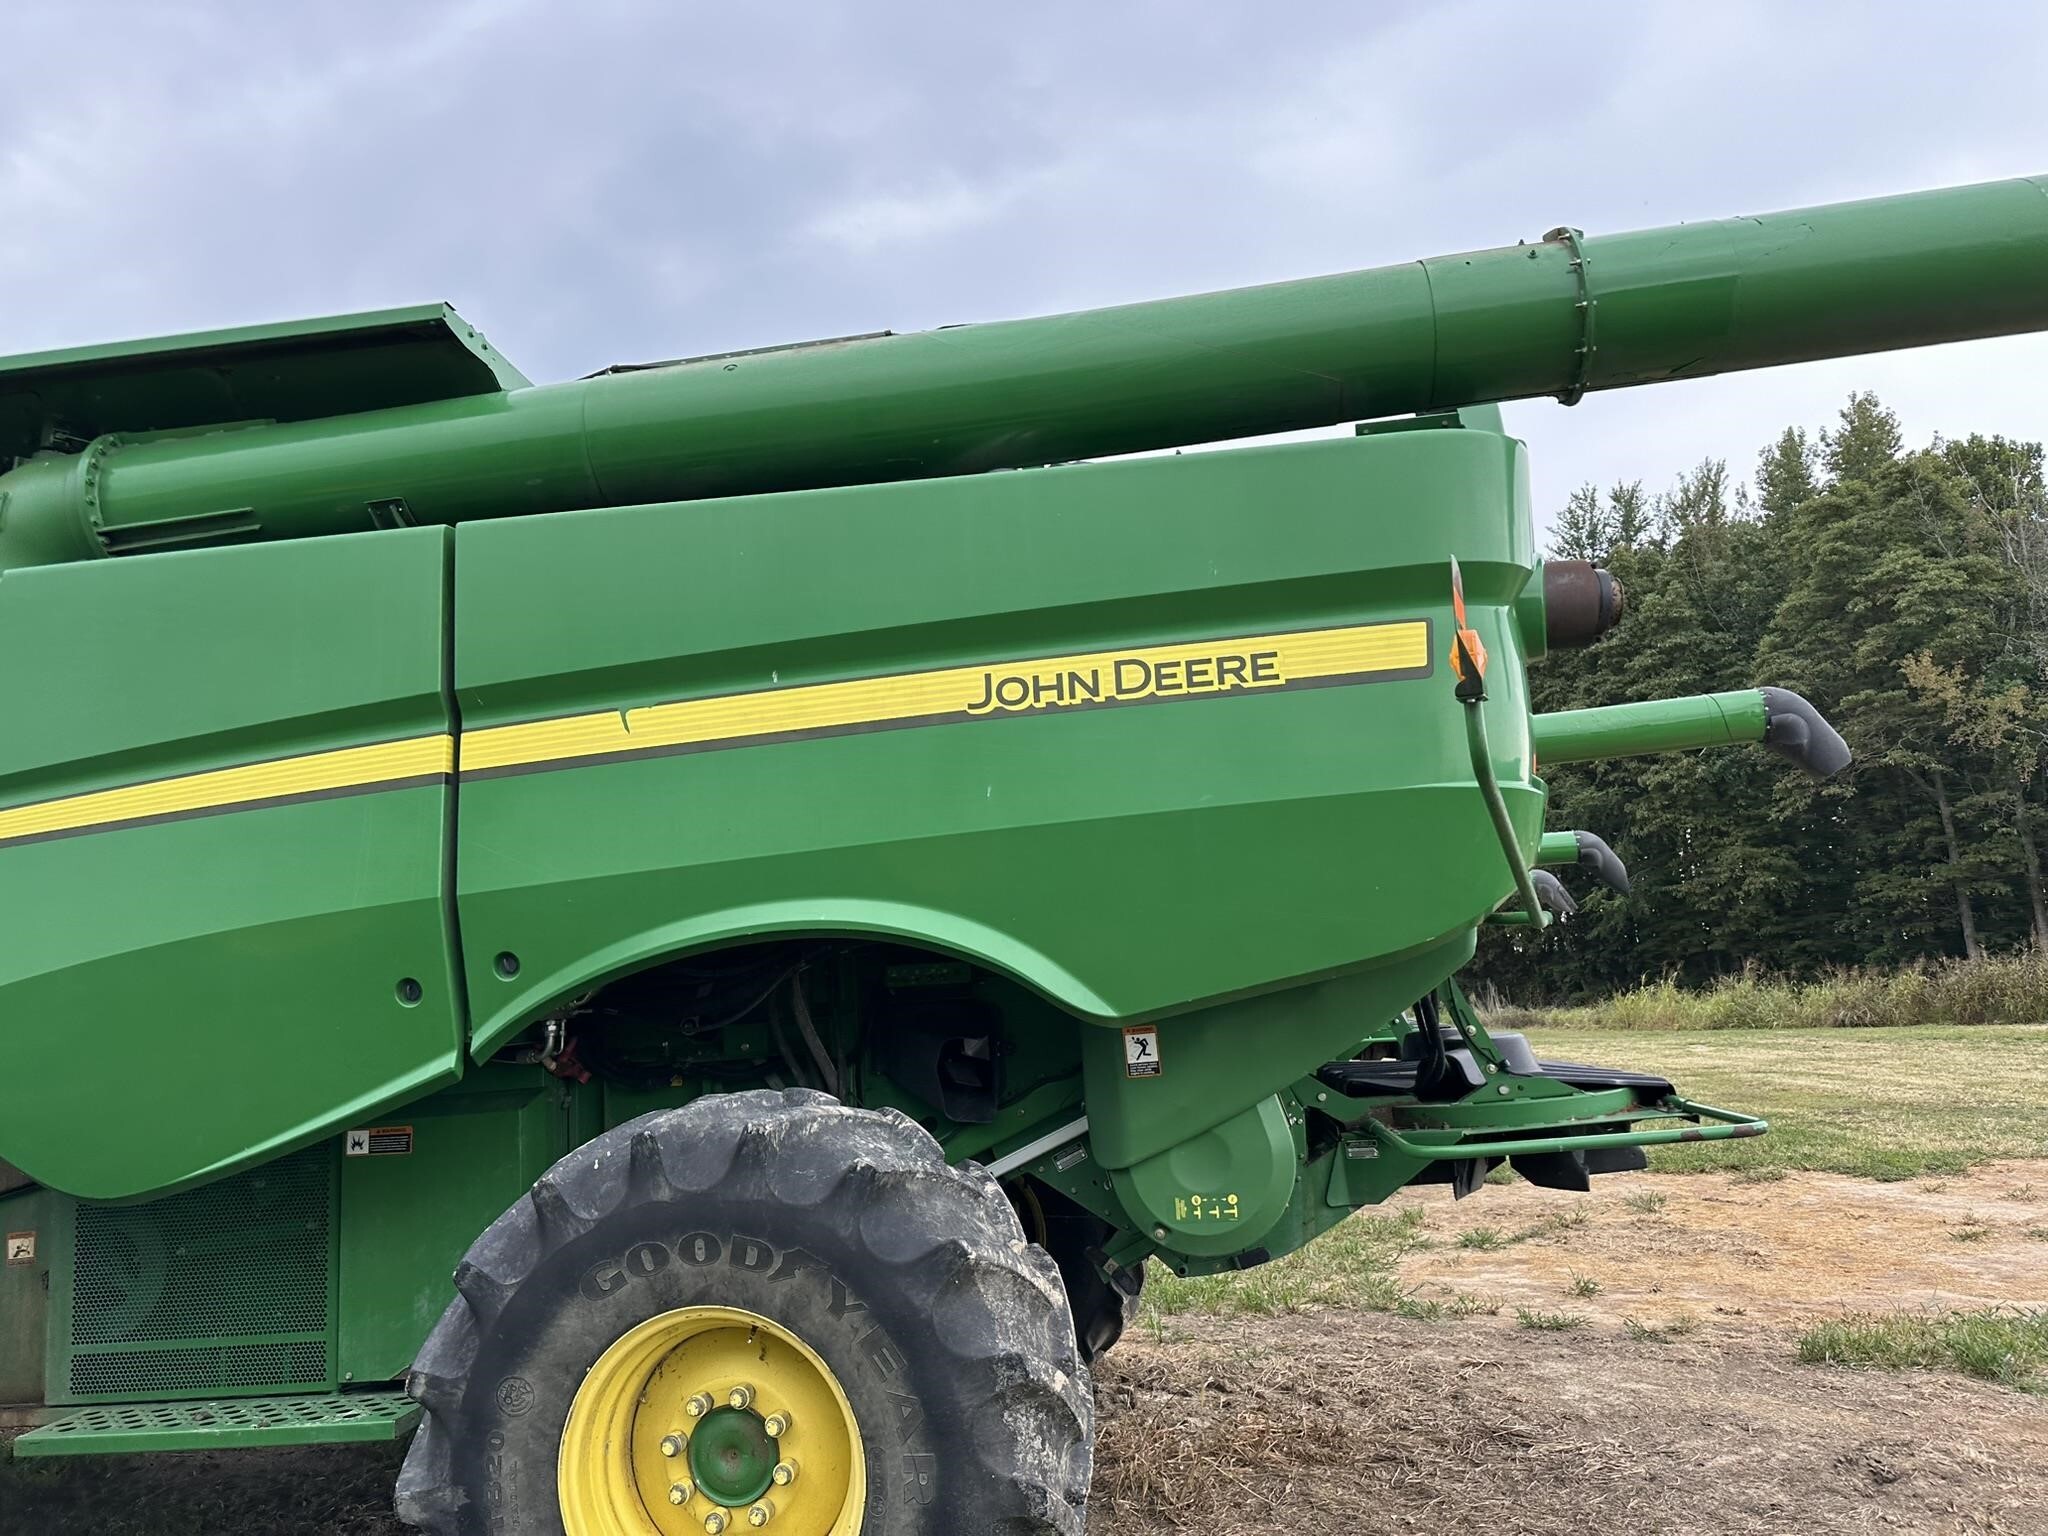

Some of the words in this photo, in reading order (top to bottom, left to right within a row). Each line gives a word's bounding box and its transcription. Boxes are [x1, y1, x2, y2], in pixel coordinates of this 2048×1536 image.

[967, 668, 1100, 711] JOHN
[1113, 651, 1280, 695] DEERE
[579, 1231, 937, 1505] GOODYEAR
